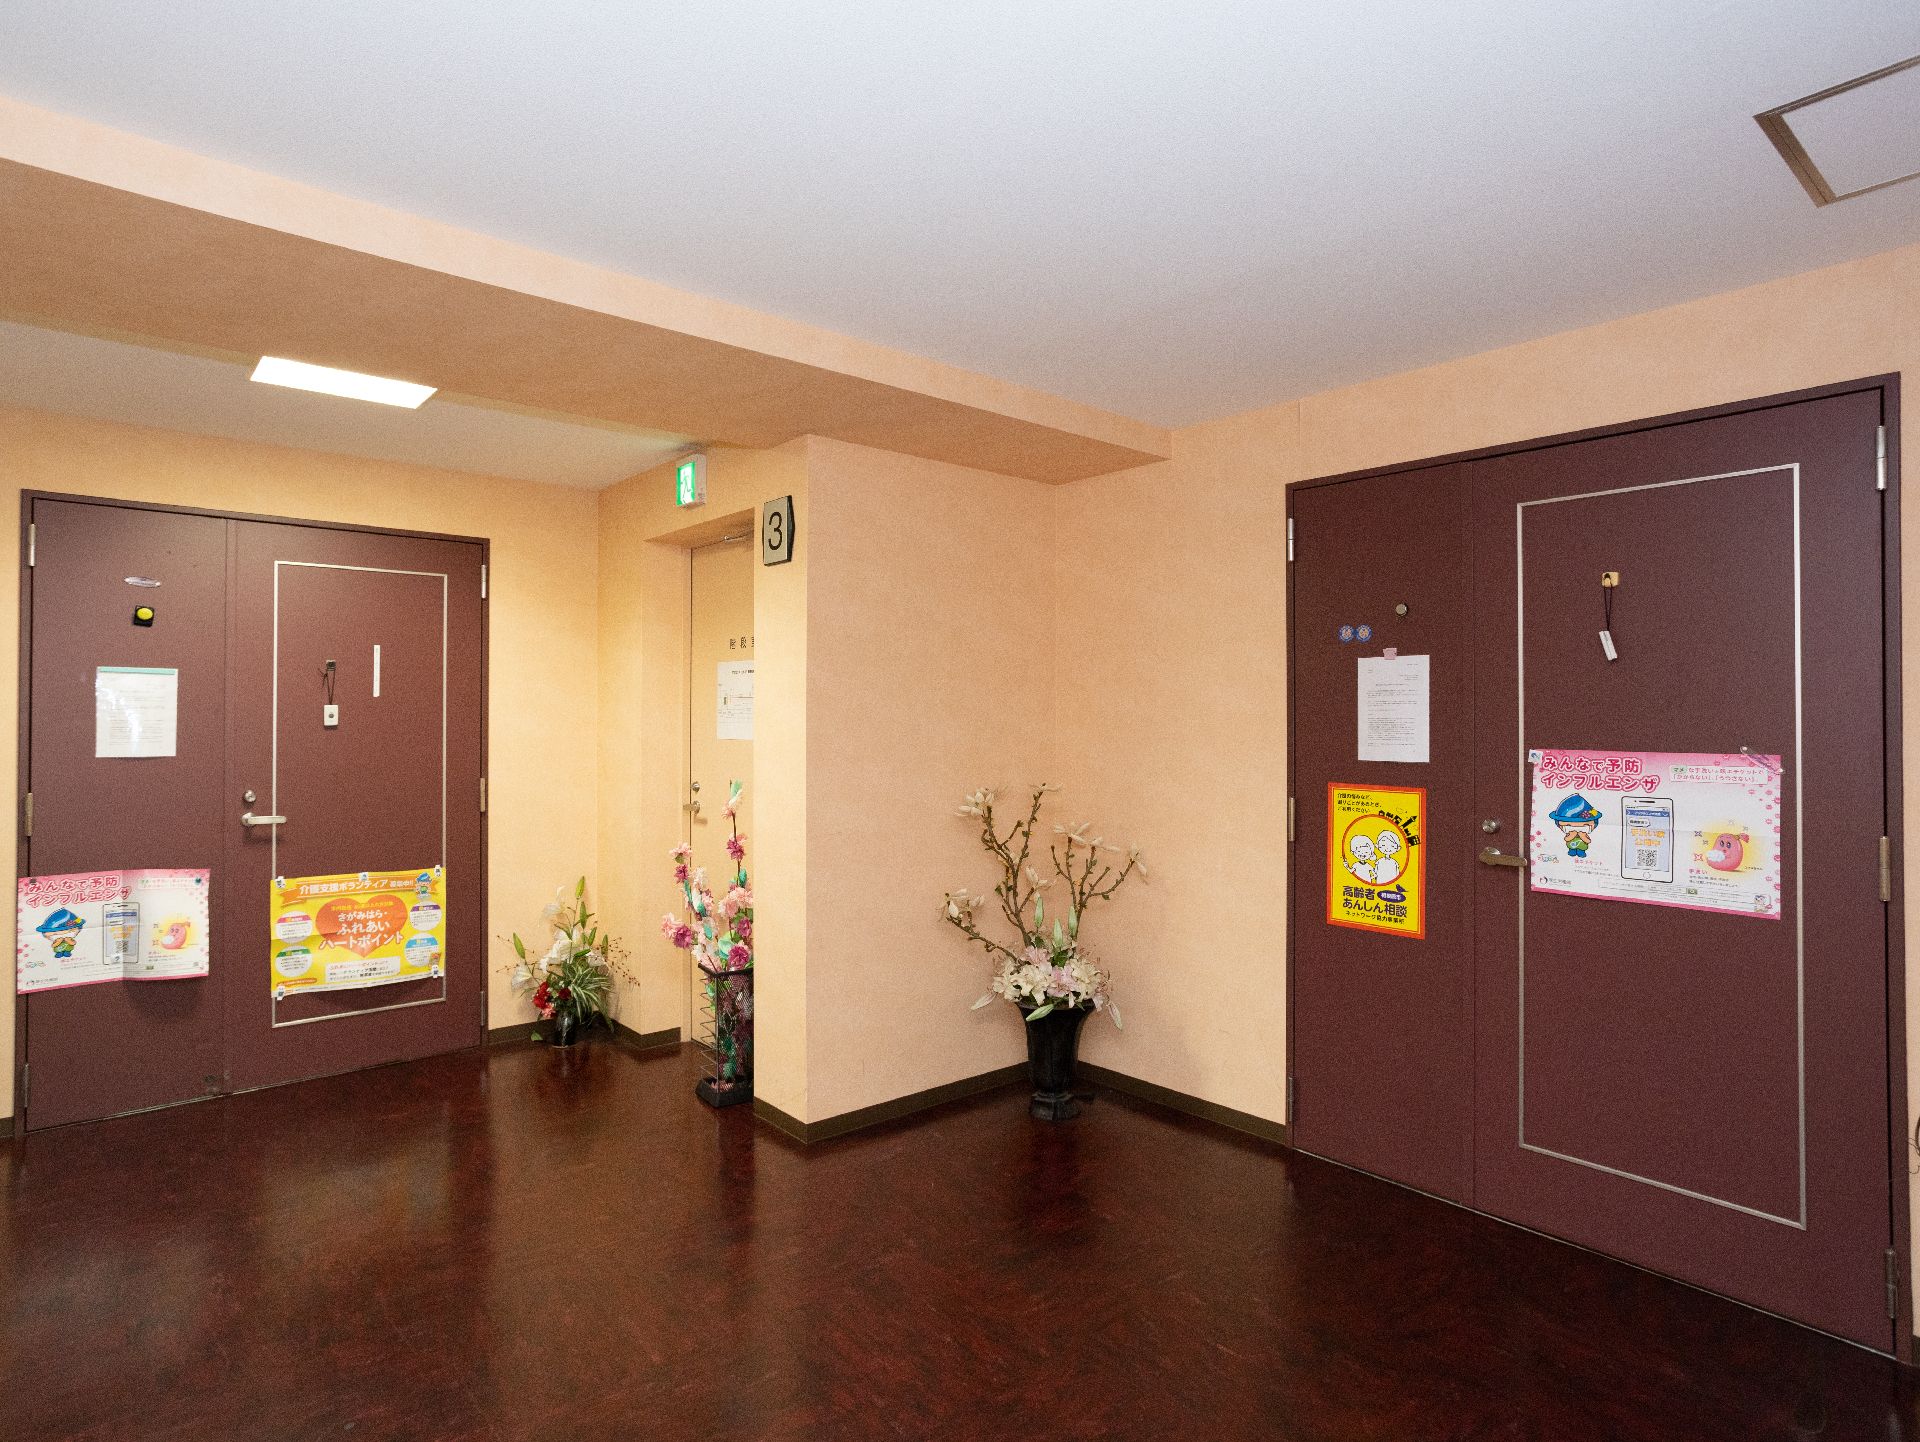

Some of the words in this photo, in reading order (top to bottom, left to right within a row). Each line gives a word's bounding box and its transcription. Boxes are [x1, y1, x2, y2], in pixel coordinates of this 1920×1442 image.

[768, 511, 783, 551] 3
[1542, 756, 1642, 775] みんなで予防
[1541, 772, 1660, 793] インフルエンザ
[28, 875, 120, 894] みんなで予防
[1343, 885, 1375, 900] 高齢者
[26, 886, 132, 908] インフルエンザ
[1342, 897, 1408, 918] あんしん相談
[336, 920, 391, 936] ふれあい
[319, 930, 404, 951] ハートポイント
